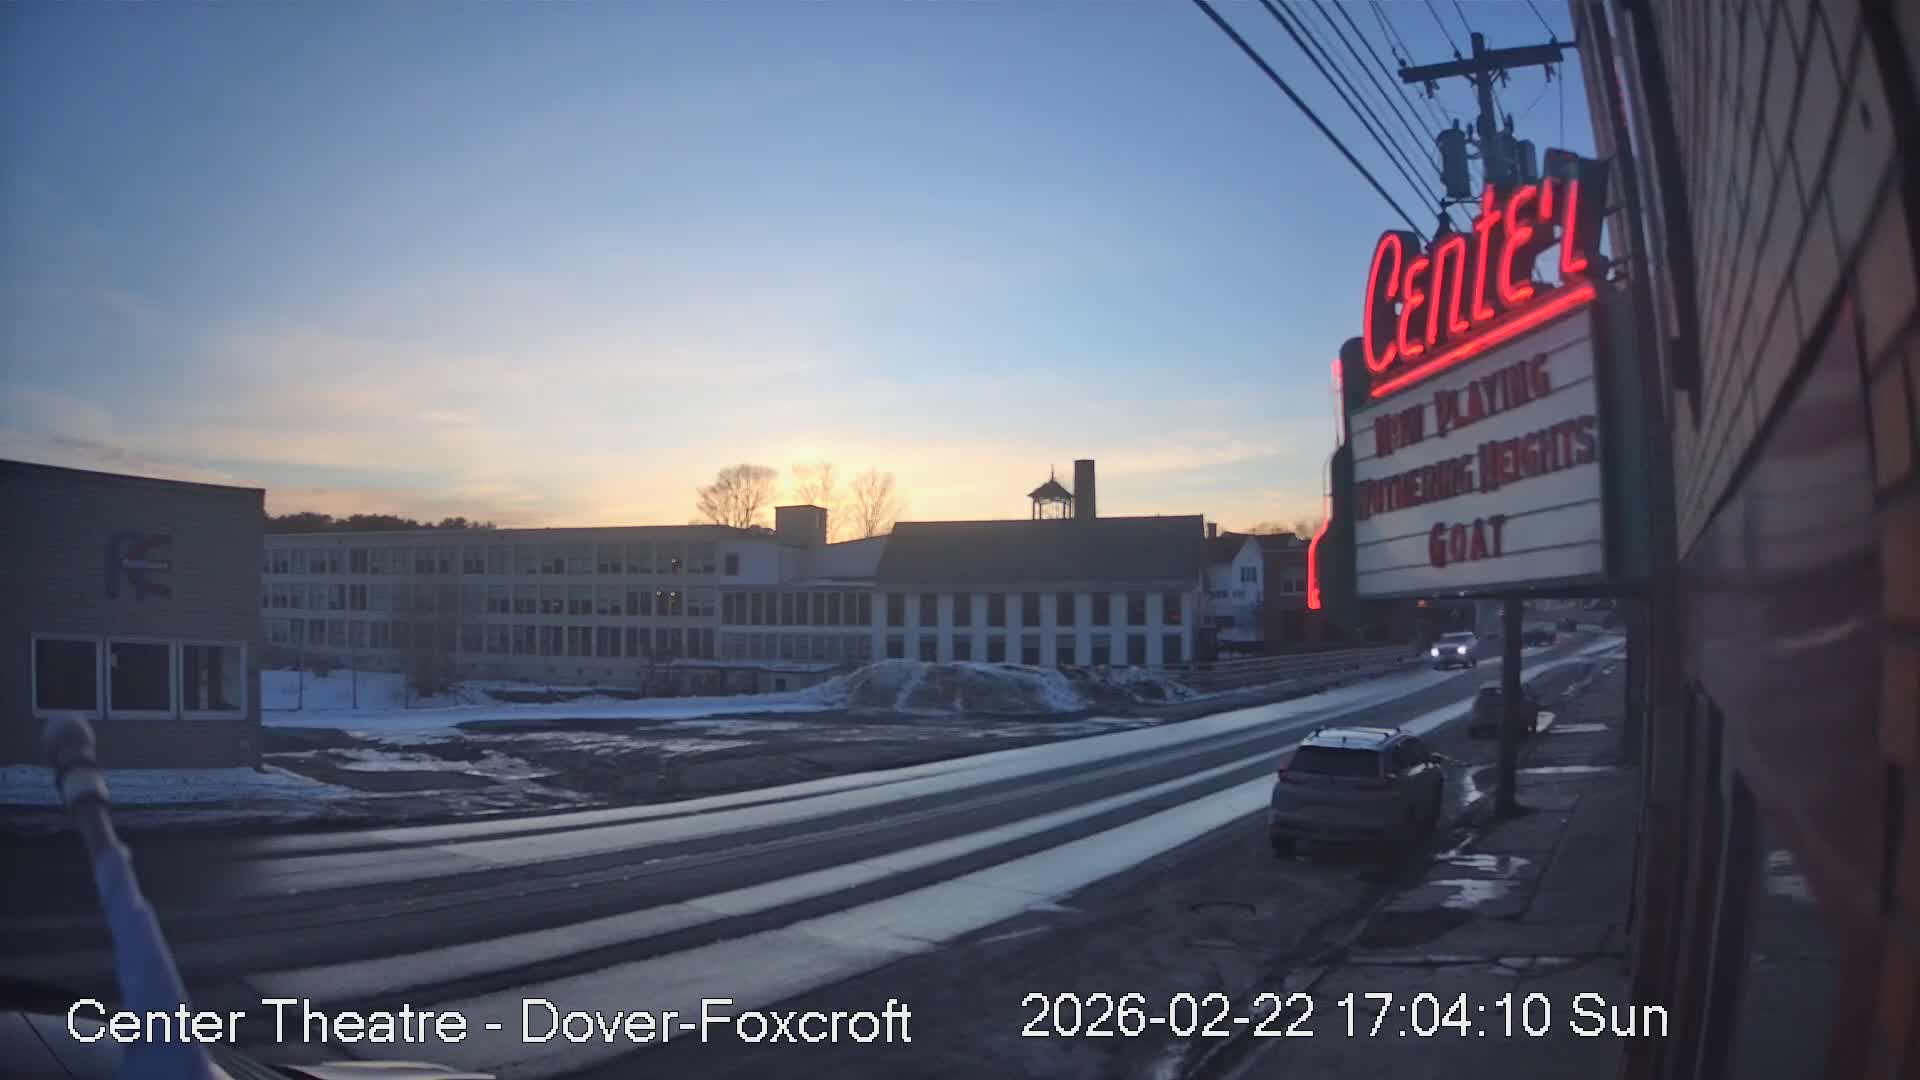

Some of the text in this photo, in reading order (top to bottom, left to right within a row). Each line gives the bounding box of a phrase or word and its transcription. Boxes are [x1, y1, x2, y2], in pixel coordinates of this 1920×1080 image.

[1434, 353, 1551, 437] PLAYING
[1478, 415, 1596, 494] HEIGHTS
[1429, 514, 1505, 568] GOAT
